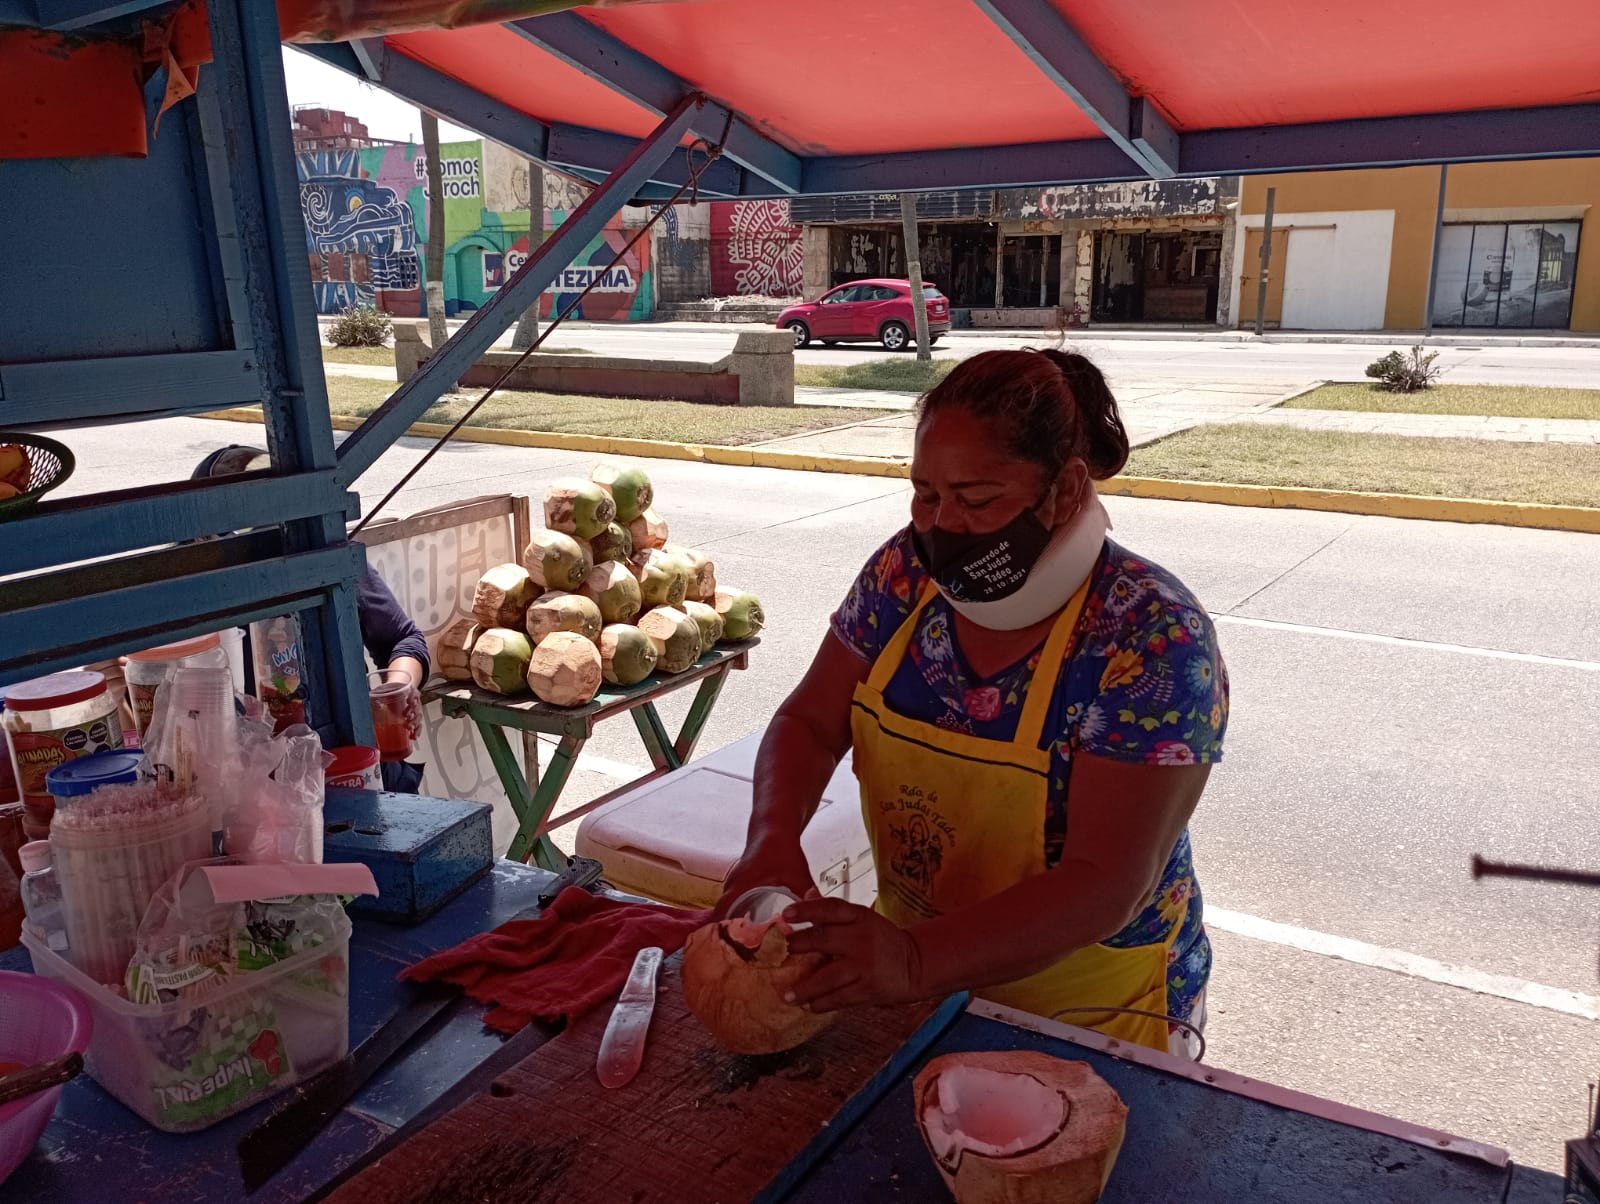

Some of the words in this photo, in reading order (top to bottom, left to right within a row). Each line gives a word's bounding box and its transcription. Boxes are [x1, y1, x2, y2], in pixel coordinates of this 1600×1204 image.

[416, 158, 479, 177] #omos
[424, 176, 480, 197] roch
[552, 269, 630, 288] TEZUMA
[963, 548, 1000, 573] Recuerdo
[998, 541, 1011, 552] de
[969, 566, 988, 580] San
[986, 553, 1012, 571] Judas
[984, 567, 1012, 584] Tadeo
[897, 798, 931, 817] Judas
[930, 811, 957, 848] Tadeo
